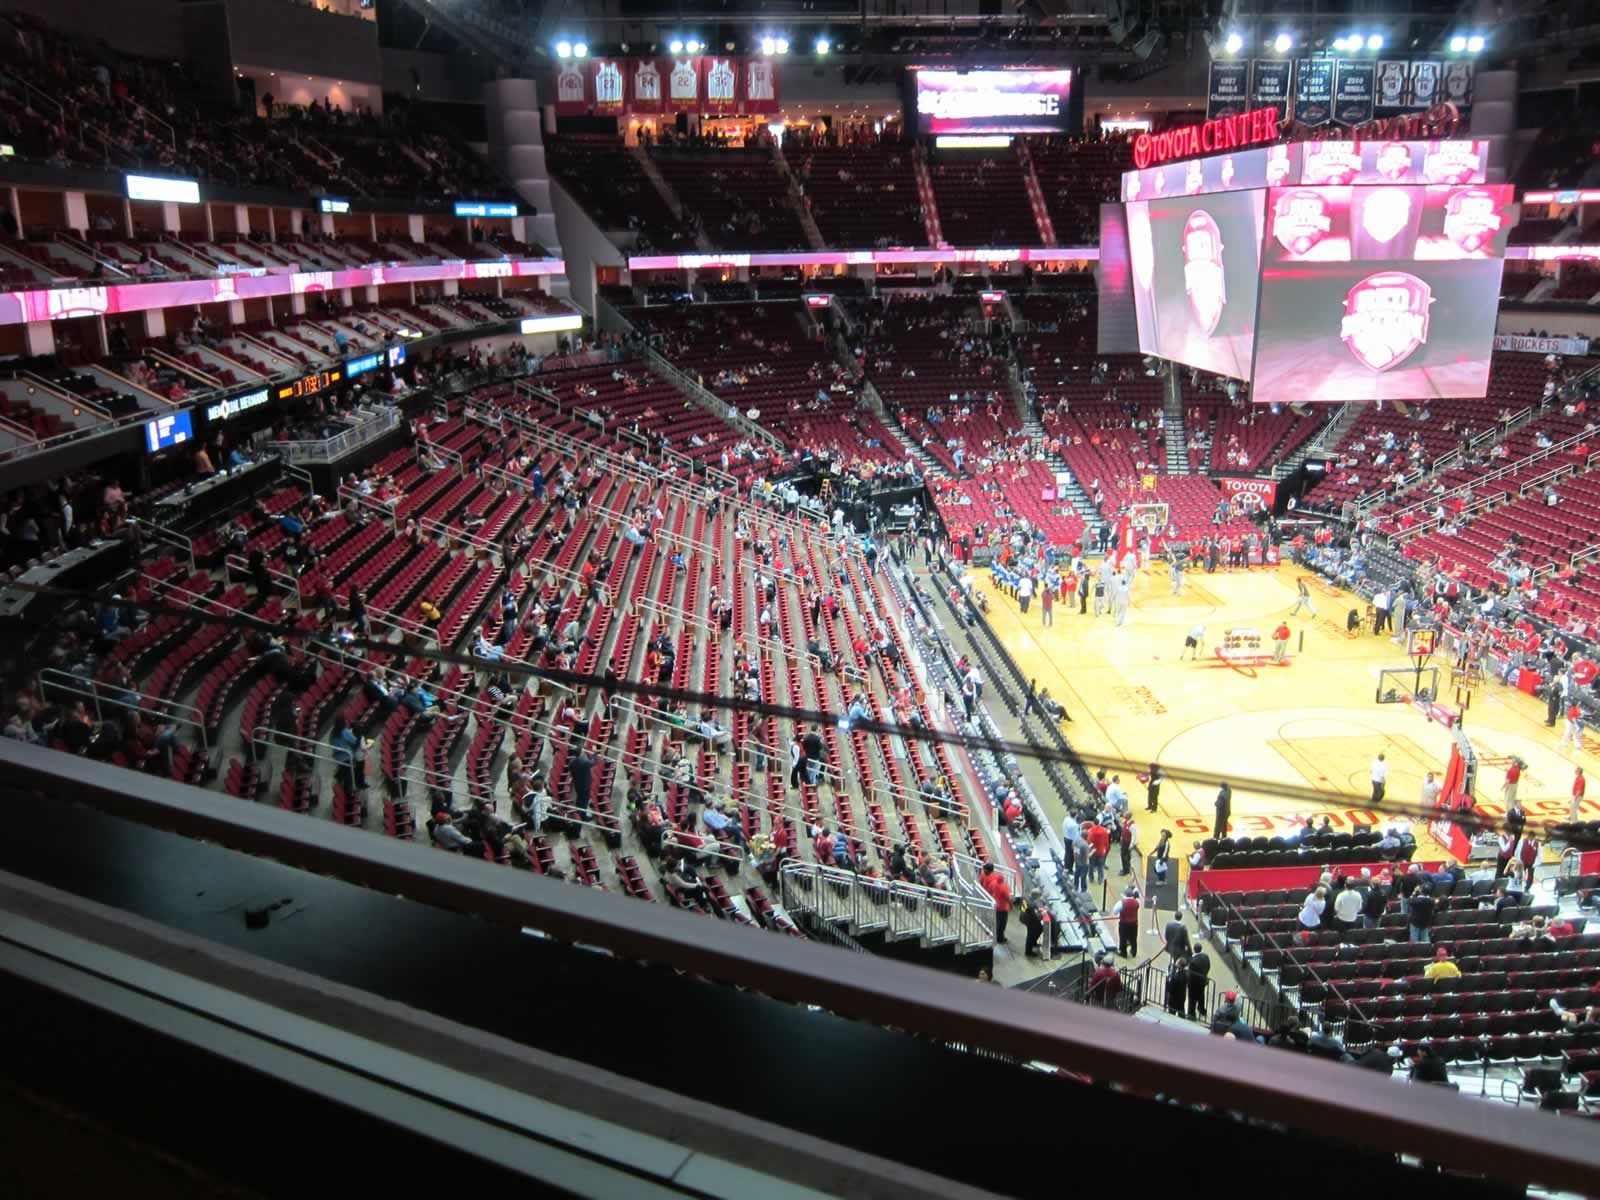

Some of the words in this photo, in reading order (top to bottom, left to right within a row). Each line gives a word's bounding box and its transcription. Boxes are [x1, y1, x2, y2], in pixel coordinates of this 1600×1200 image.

[1151, 125, 1200, 162] TOYOTA
[1202, 107, 1278, 151] CENTER
[1510, 337, 1560, 351] ROCKETS
[1225, 480, 1272, 494] TOYOTA
